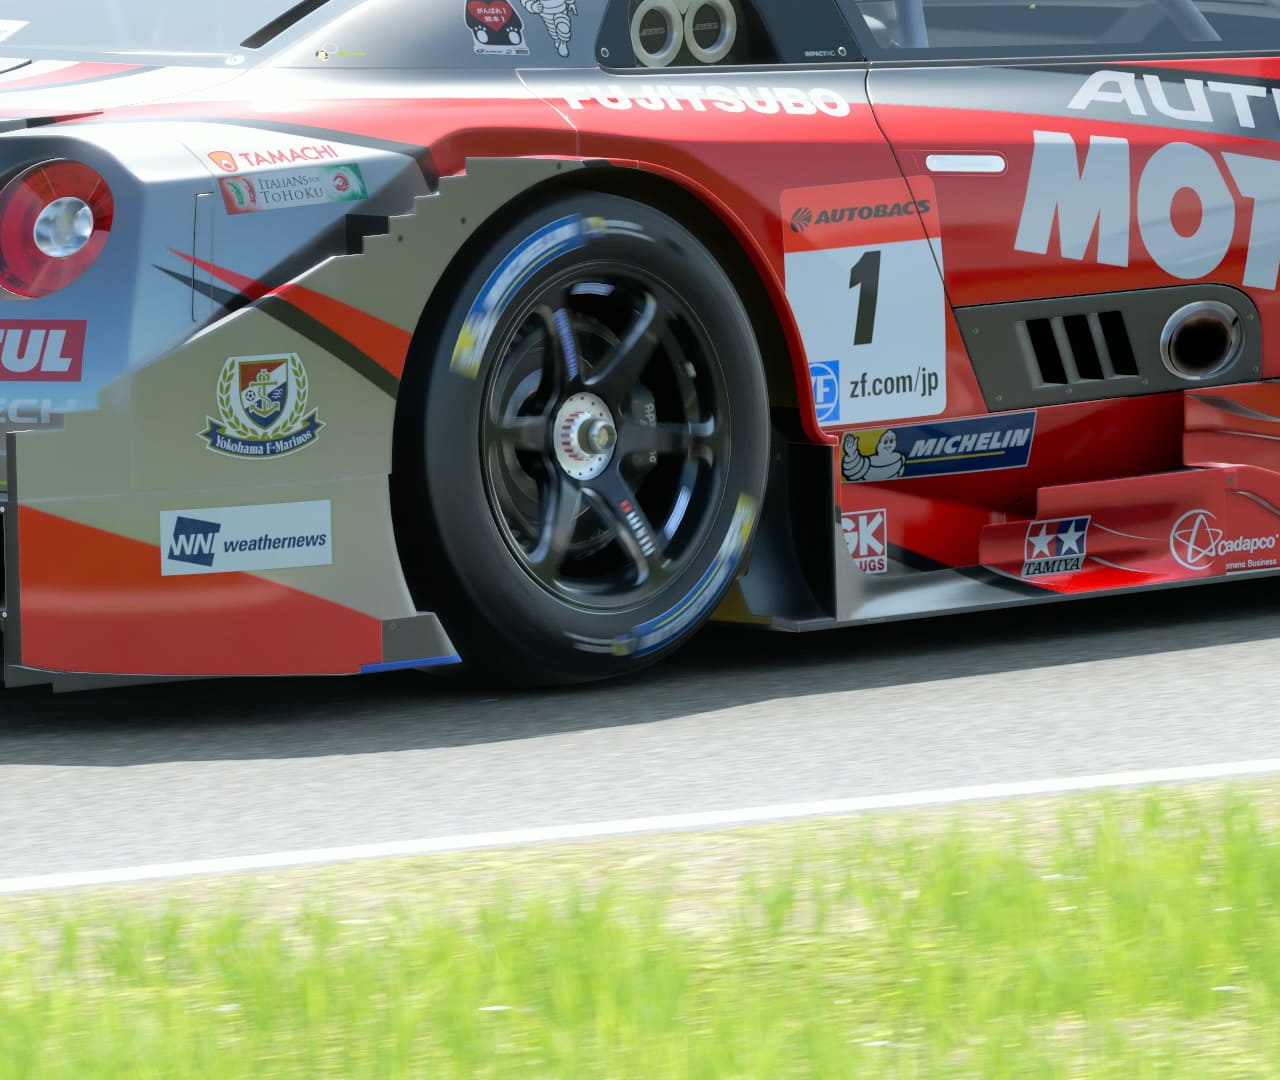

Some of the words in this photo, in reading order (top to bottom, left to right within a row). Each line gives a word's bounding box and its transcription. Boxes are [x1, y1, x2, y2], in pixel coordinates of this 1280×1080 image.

[558, 85, 850, 117] FUJITSUBO
[239, 145, 339, 167] TAMACHI
[815, 200, 931, 225] AUTOBACS
[849, 250, 881, 346] 1
[850, 366, 938, 398] zf.com/jp
[216, 434, 264, 455] Yokohama
[909, 428, 1030, 458] MICHELIN
[224, 533, 327, 552] weathernews
[1024, 557, 1081, 576] TAMIYA
